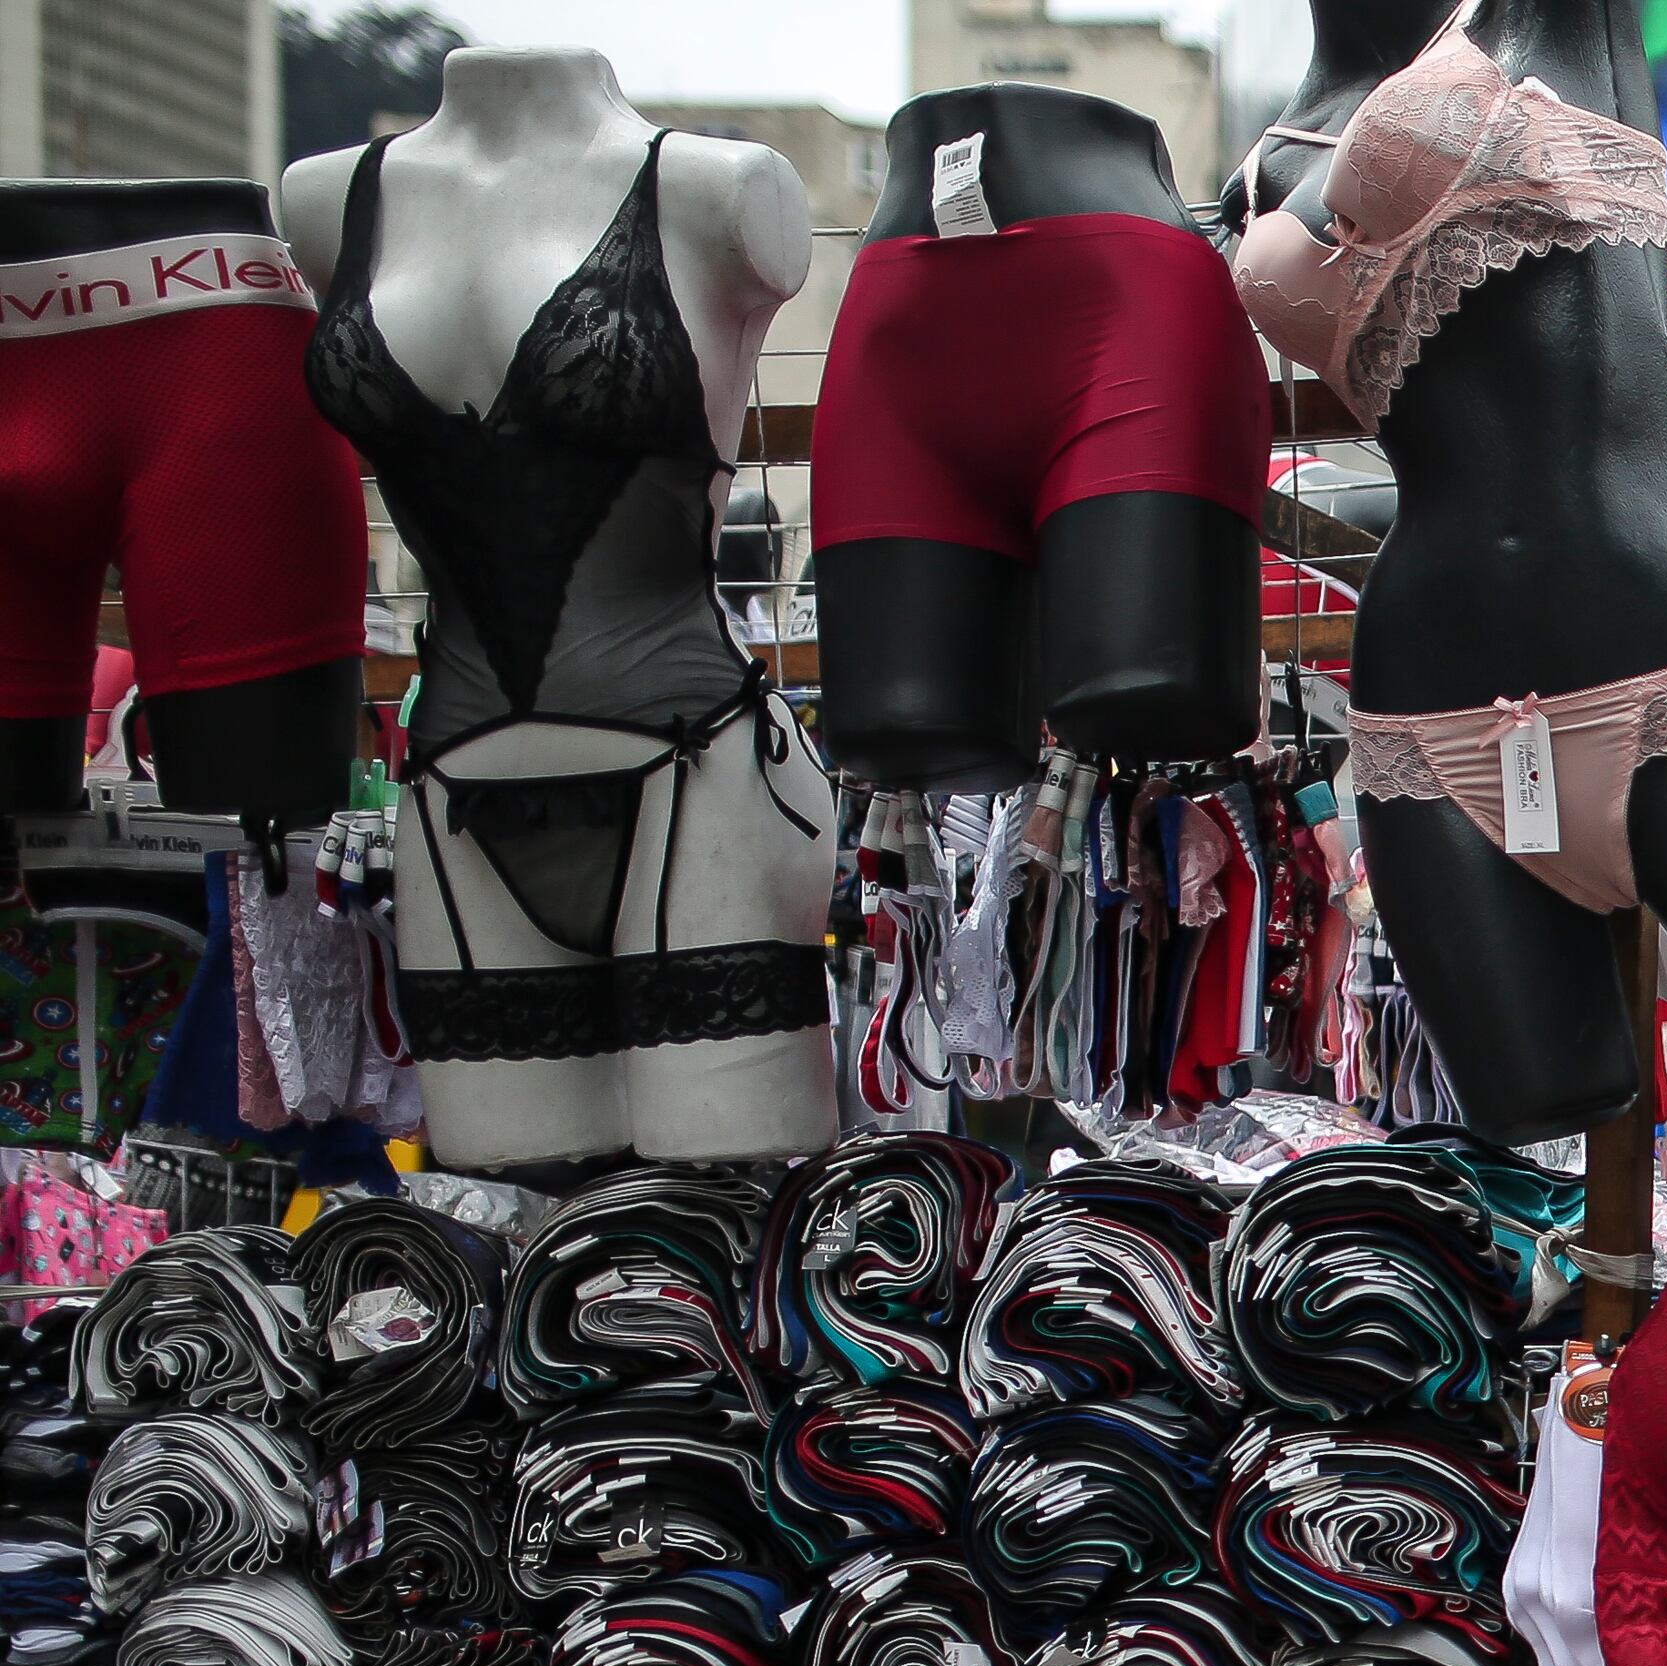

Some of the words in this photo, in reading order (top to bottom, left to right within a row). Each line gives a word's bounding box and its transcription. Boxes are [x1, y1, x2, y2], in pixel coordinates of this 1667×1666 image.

[150, 247, 312, 300] Klein
[816, 1199, 850, 1231] ck
[815, 1243, 841, 1252] TALLA
[526, 1512, 555, 1543] ck
[617, 1518, 653, 1549] ck
